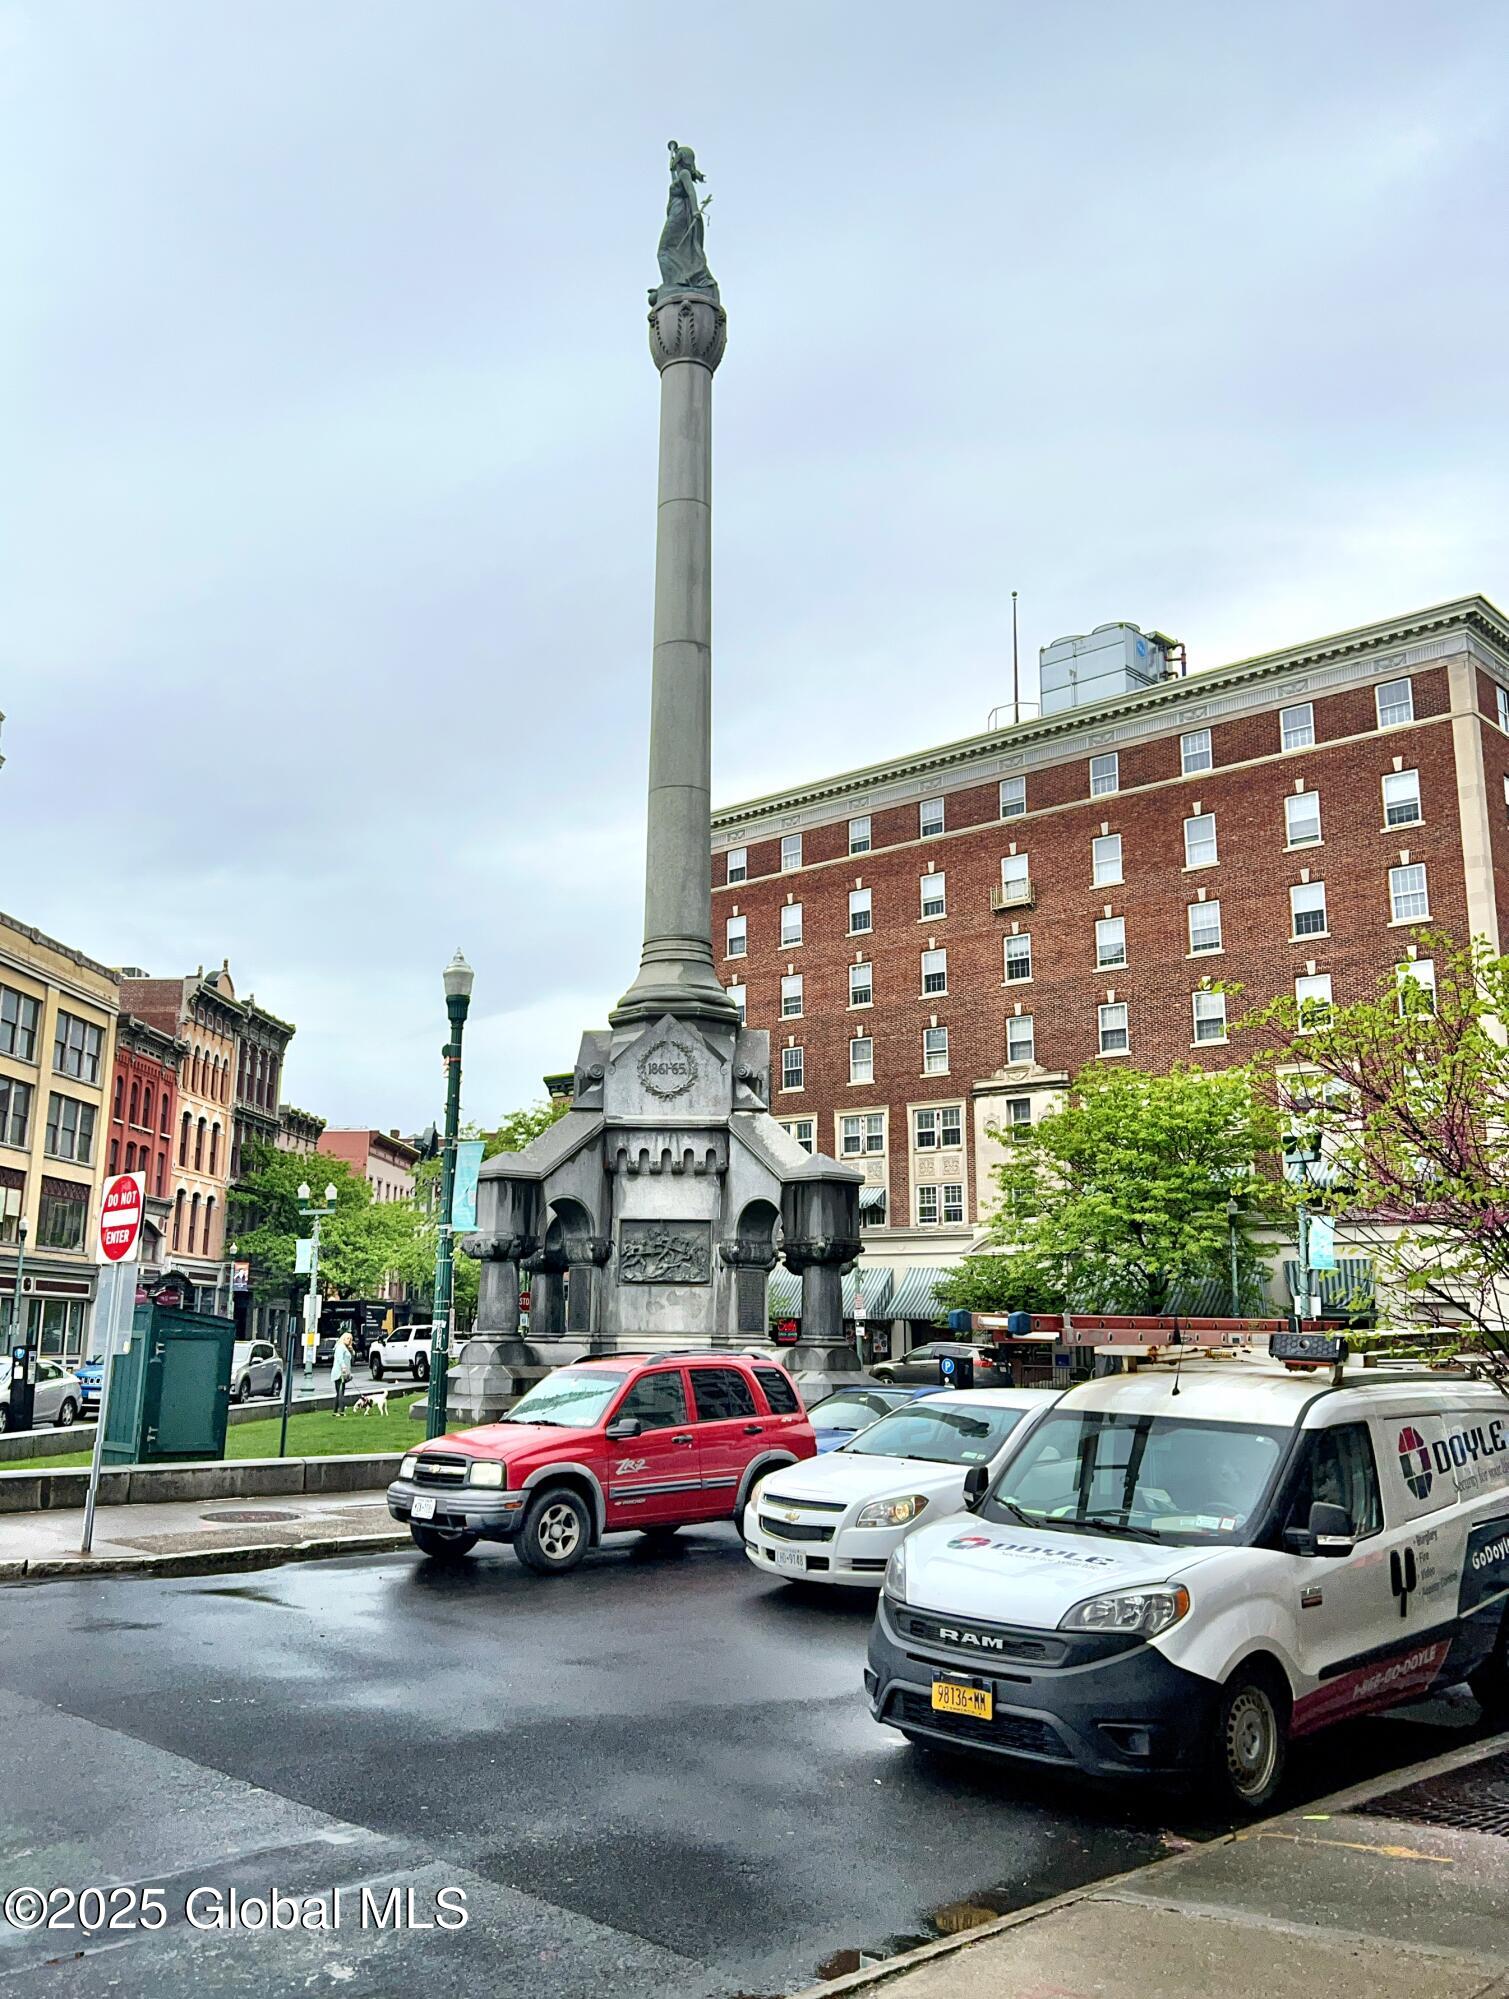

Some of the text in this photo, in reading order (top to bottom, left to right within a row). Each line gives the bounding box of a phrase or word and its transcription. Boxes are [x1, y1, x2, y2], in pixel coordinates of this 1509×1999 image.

[108, 1190, 138, 1207] DO NOT
[106, 1229, 130, 1244] ENTER
[1432, 1420, 1507, 1474] DOYLE
[990, 1543, 1116, 1566] DOYLE
[940, 1628, 1003, 1649] RAM
